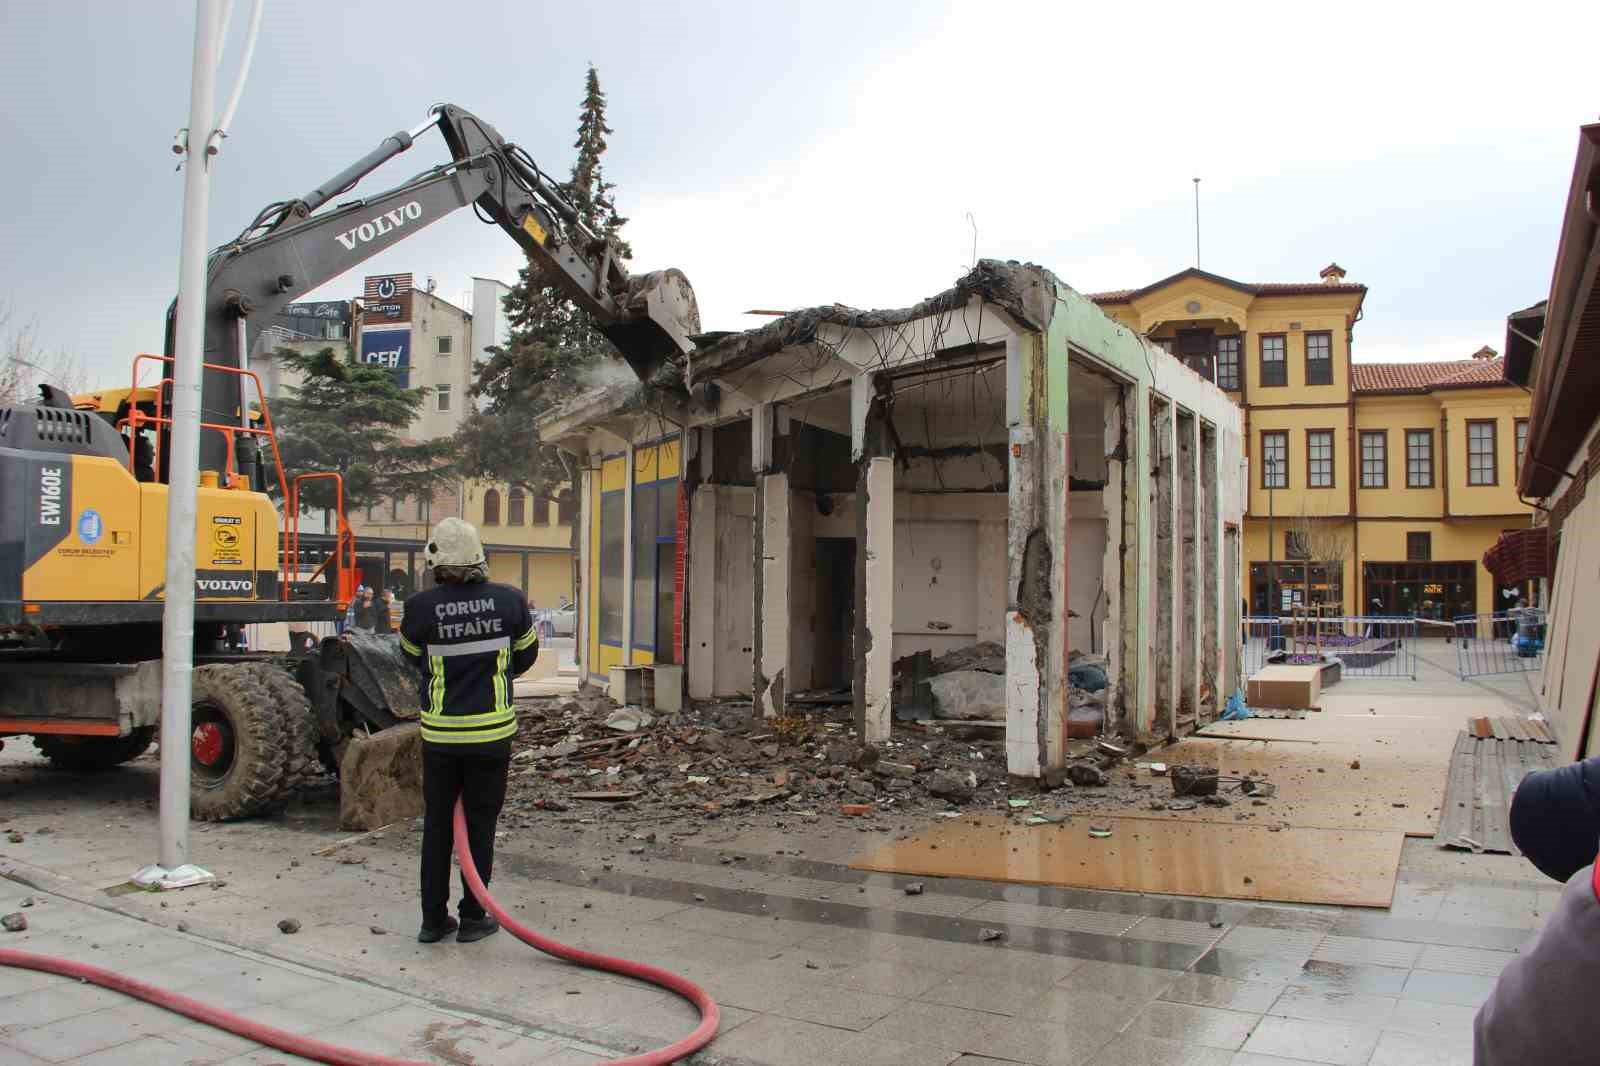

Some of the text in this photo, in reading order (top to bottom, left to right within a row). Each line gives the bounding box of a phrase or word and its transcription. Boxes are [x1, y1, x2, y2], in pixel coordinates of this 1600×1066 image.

[335, 201, 421, 250] VOLVO
[40, 467, 61, 525] EW160E
[196, 580, 253, 590] VOLVO
[435, 598, 496, 620] ÇORUM
[438, 617, 502, 639] İTFAİYE
